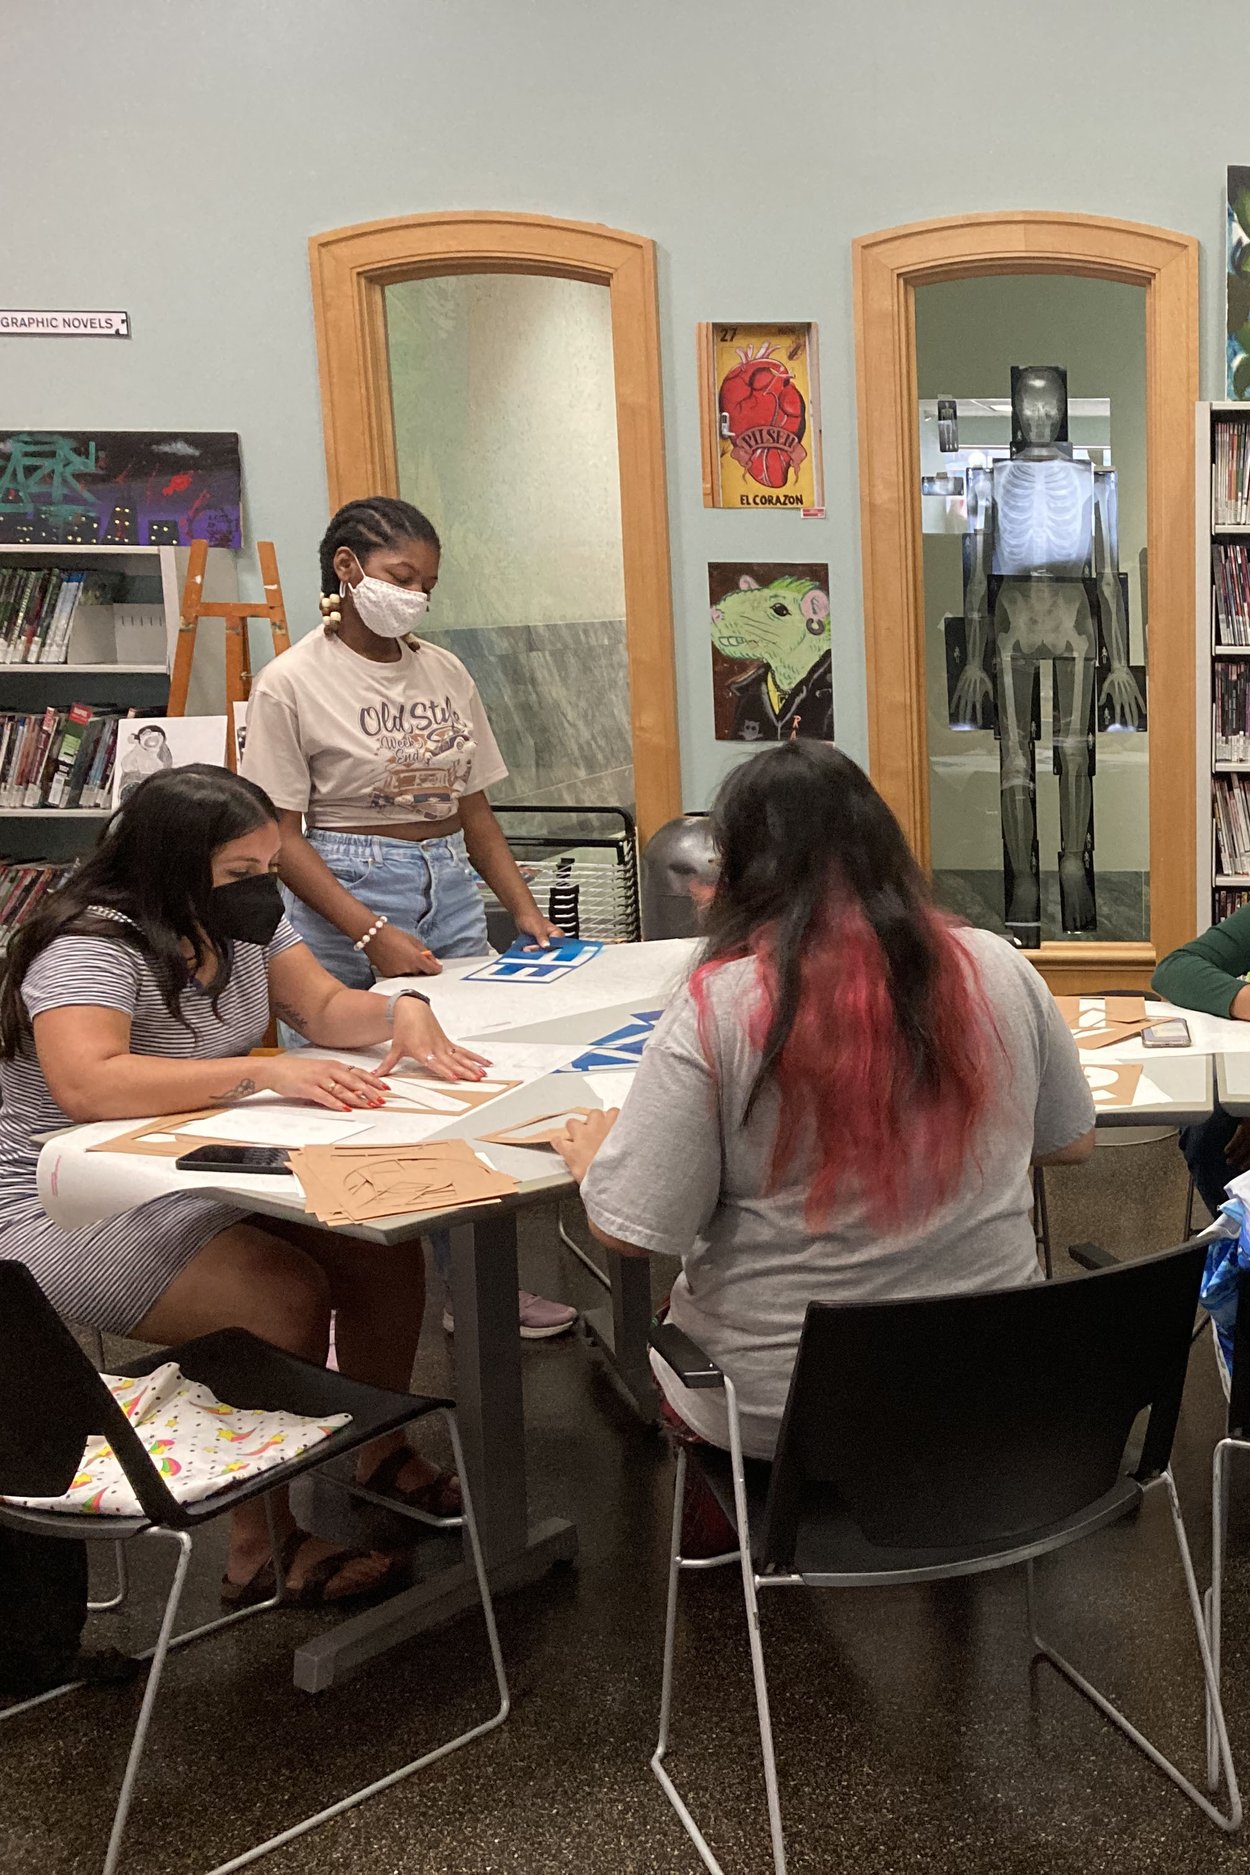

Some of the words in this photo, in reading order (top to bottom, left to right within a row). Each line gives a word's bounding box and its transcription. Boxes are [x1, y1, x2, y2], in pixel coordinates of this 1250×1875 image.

[0, 316, 59, 329] GRAPHIC
[62, 318, 114, 330] NOVELS
[720, 327, 738, 343] 27
[740, 494, 754, 505] EL
[755, 494, 804, 506] CORAZON
[360, 701, 414, 736] Old
[410, 696, 468, 742] Style
[395, 749, 420, 764] End
